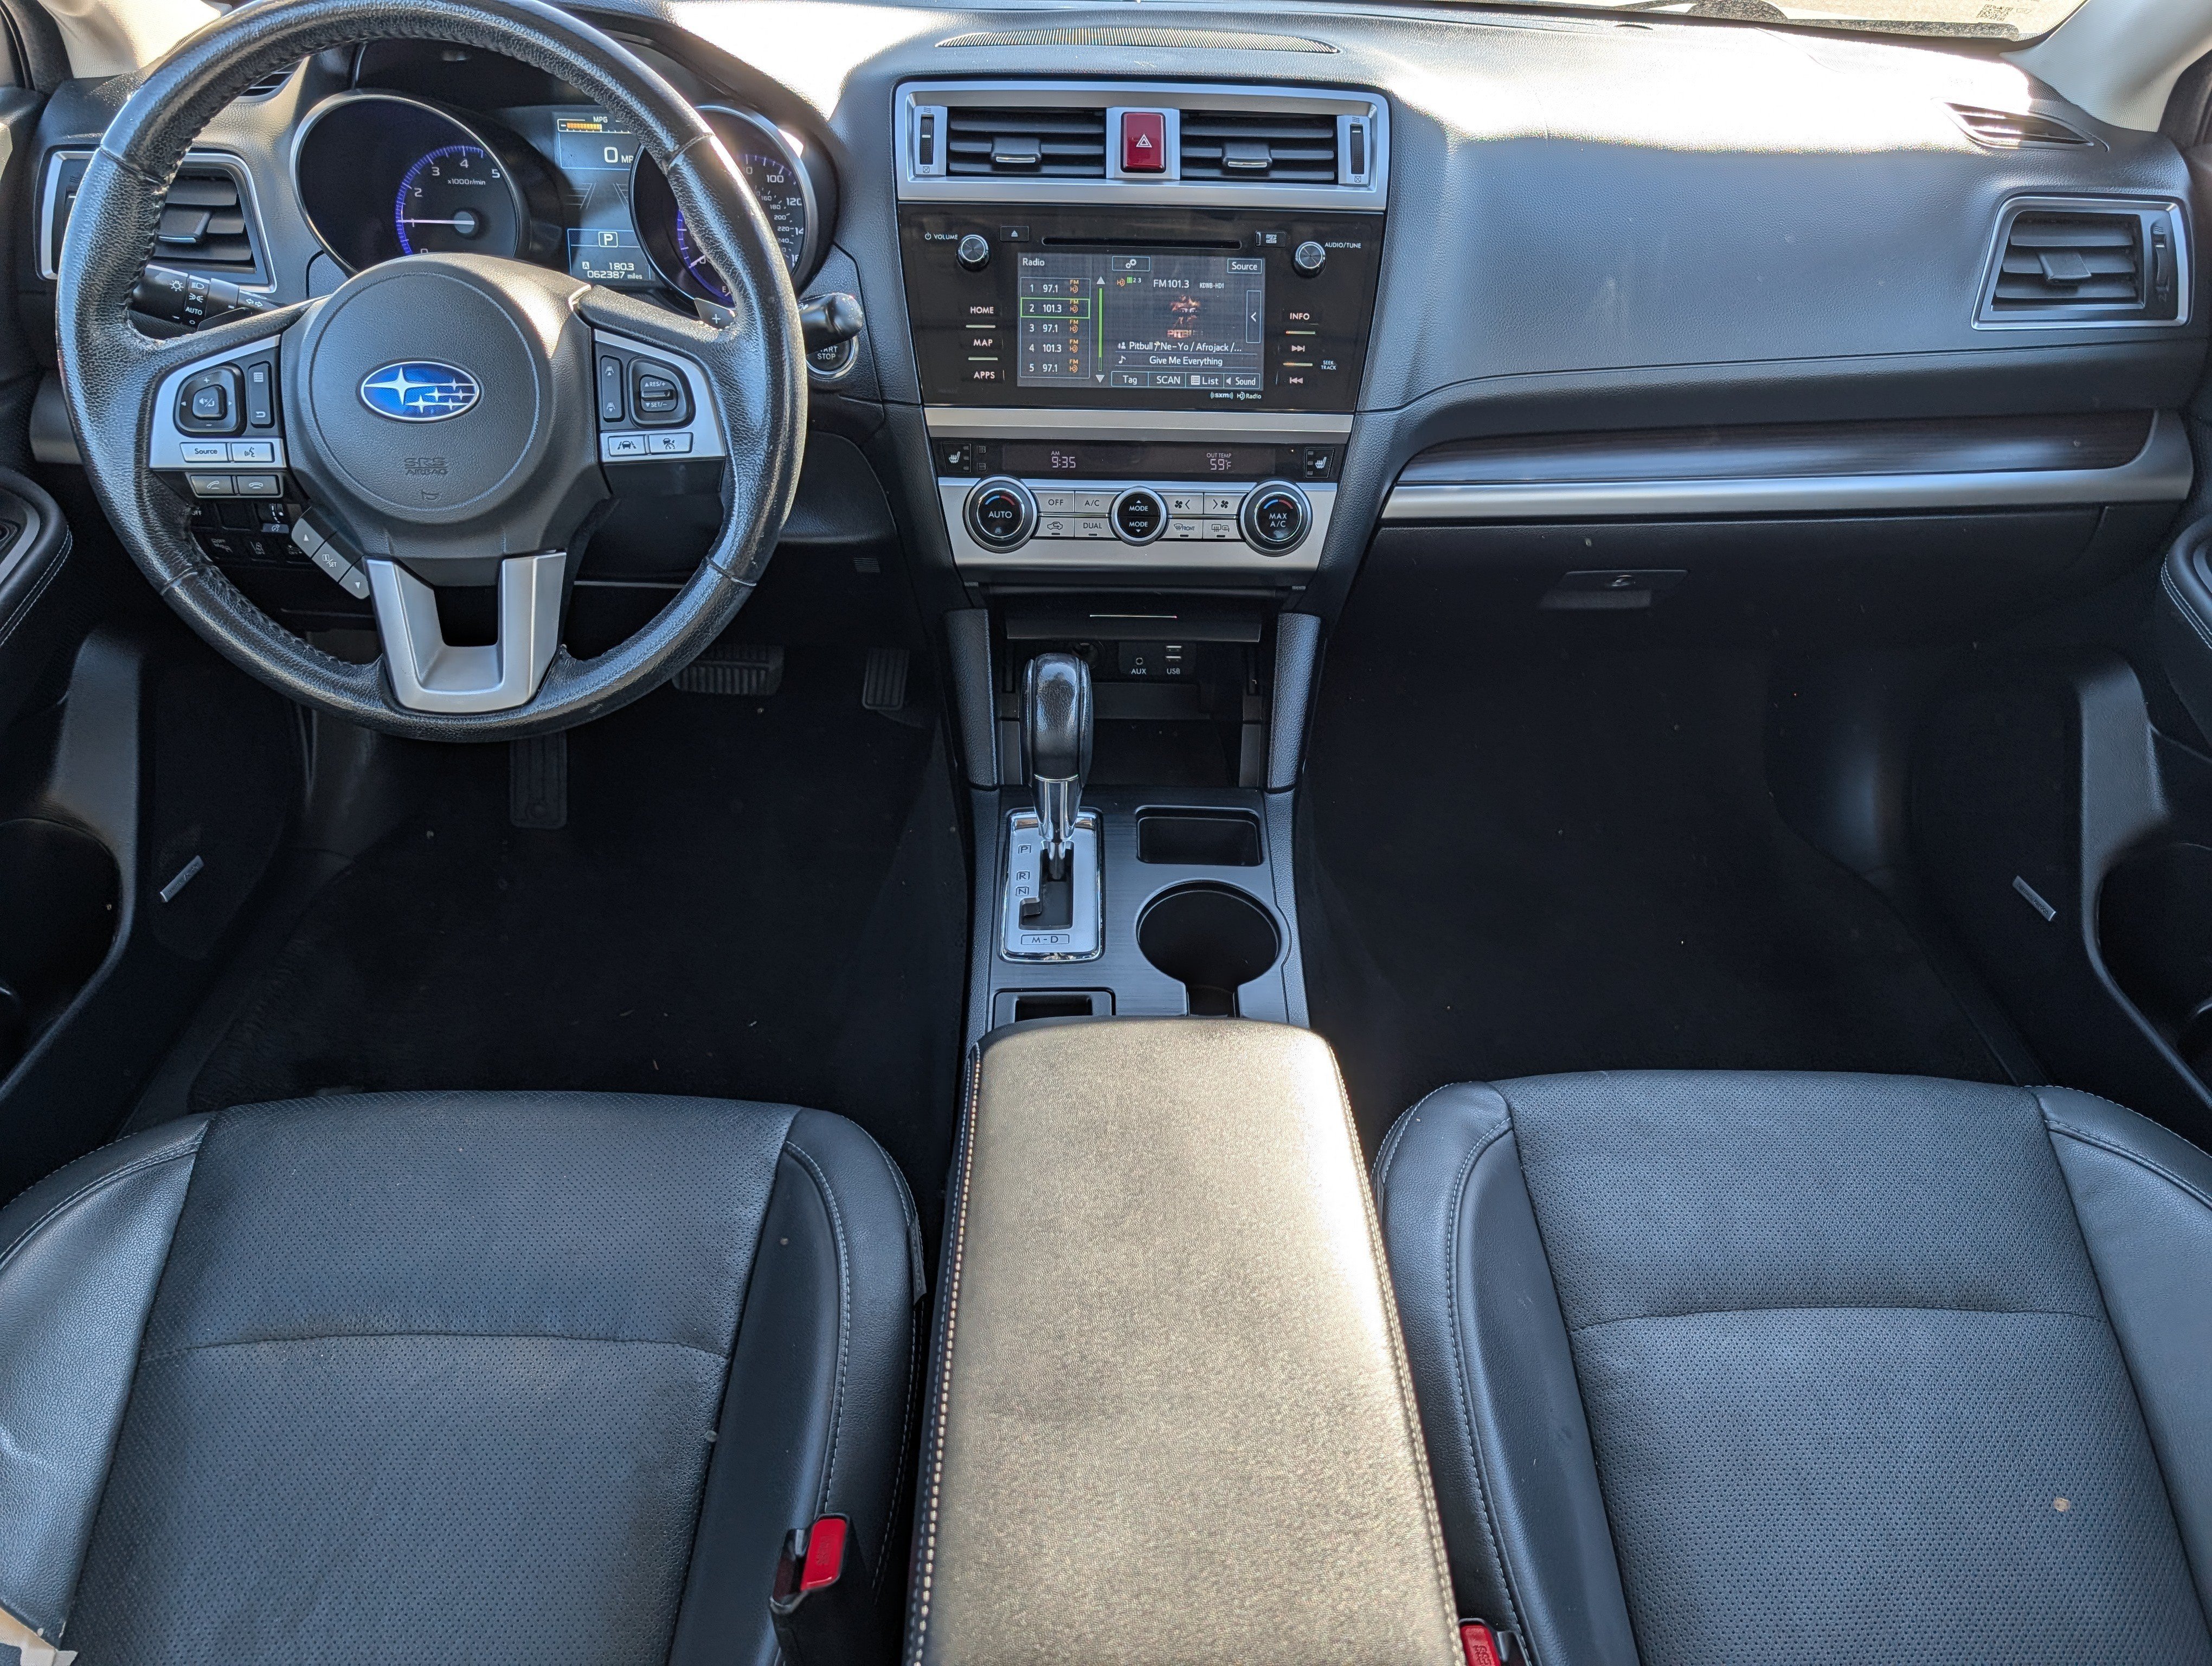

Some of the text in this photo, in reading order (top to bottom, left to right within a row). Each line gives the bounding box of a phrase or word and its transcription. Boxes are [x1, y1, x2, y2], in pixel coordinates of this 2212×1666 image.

[604, 147, 618, 163] 0
[460, 159, 468, 168] 4
[432, 167, 440, 176] 3
[492, 169, 500, 178] 5
[767, 175, 784, 183] 100
[414, 188, 422, 197] 2
[795, 227, 803, 235] 14
[604, 234, 613, 245] P
[1023, 258, 1045, 266] Radio
[1232, 262, 1257, 271] Source
[587, 271, 625, 279] 062387
[1030, 284, 1058, 293] 1 97.1
[185, 306, 202, 316] AUTO
[1030, 304, 1062, 313] 2 101.3
[1030, 324, 1058, 333] 3 97.1
[1029, 344, 1062, 353] 4 101.3
[1129, 342, 1153, 350] Pitbull
[1197, 342, 1229, 353] Afrojack
[1183, 357, 1223, 367] Everything
[1030, 364, 1058, 373] 5 97.1
[1122, 375, 1137, 385] Tag
[1156, 376, 1180, 384] SCAN
[1203, 377, 1219, 385] List
[1236, 377, 1256, 386] Sound
[1052, 457, 1076, 468] 9:35
